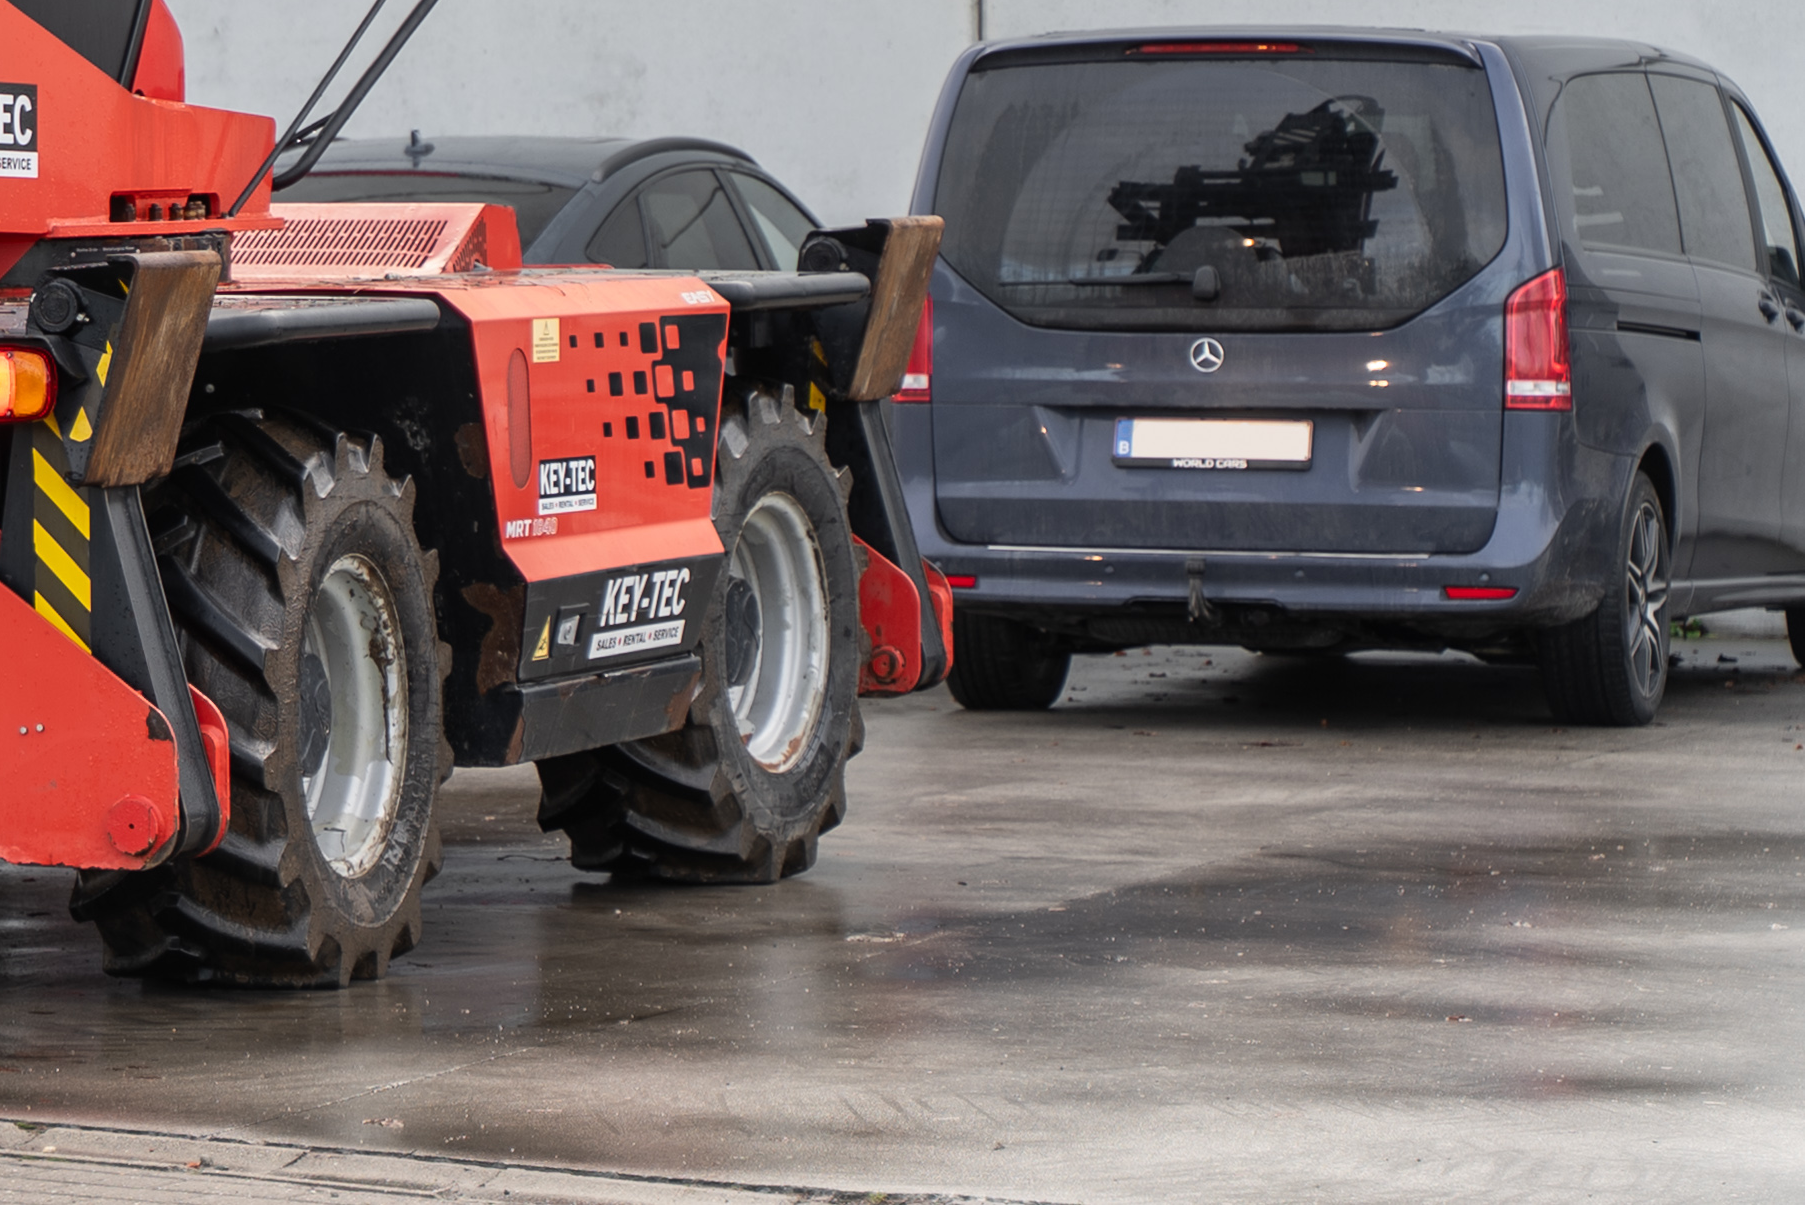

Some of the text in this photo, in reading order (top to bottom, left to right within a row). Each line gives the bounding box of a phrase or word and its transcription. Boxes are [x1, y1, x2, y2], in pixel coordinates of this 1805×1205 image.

[1118, 440, 1130, 455] B
[1172, 458, 1248, 470] WORLD CARS
[540, 458, 595, 496] KEY-TEC
[505, 518, 532, 539] MRT
[599, 567, 691, 628] KEY-TEC
[595, 626, 680, 652] SALES RENTAL SERVICE
